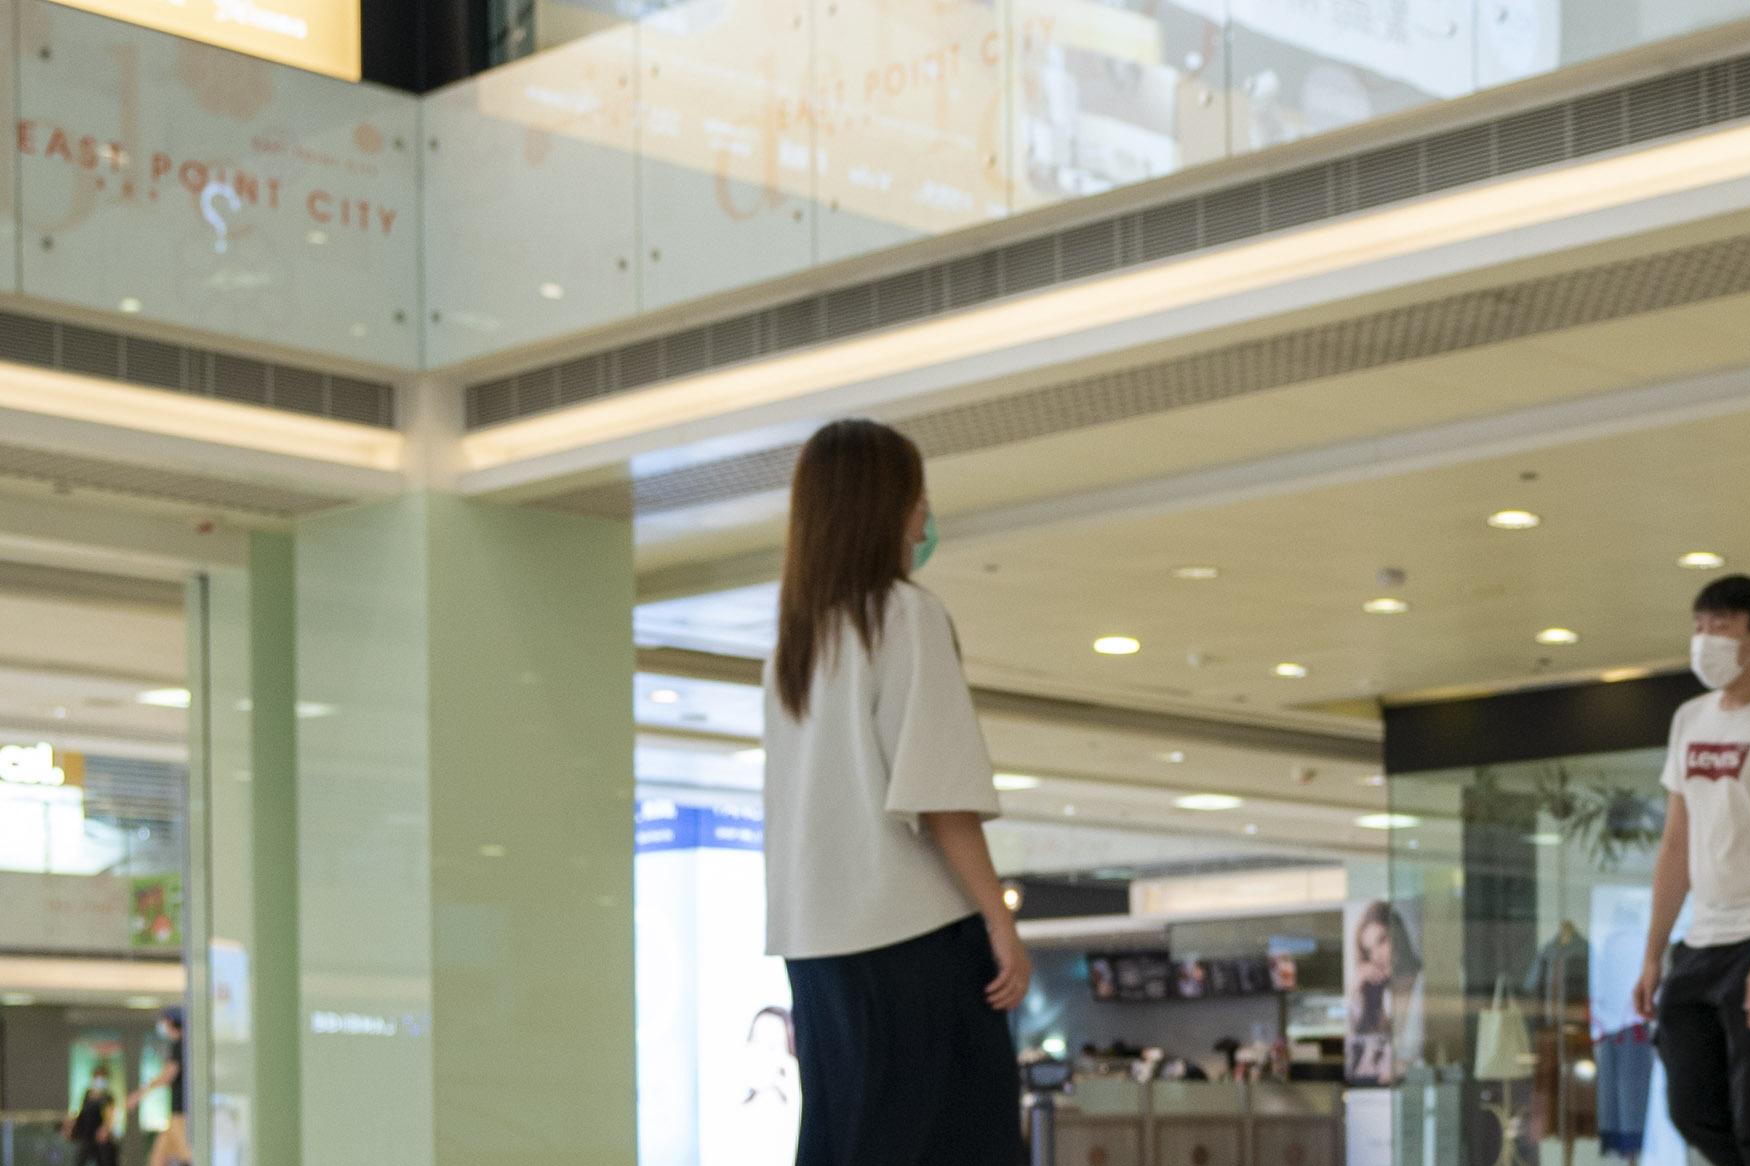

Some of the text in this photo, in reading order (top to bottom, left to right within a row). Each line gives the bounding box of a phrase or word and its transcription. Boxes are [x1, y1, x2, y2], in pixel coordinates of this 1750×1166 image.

[16, 119, 129, 172] EAST
[150, 152, 282, 209] POINT
[305, 189, 398, 235] CITY
